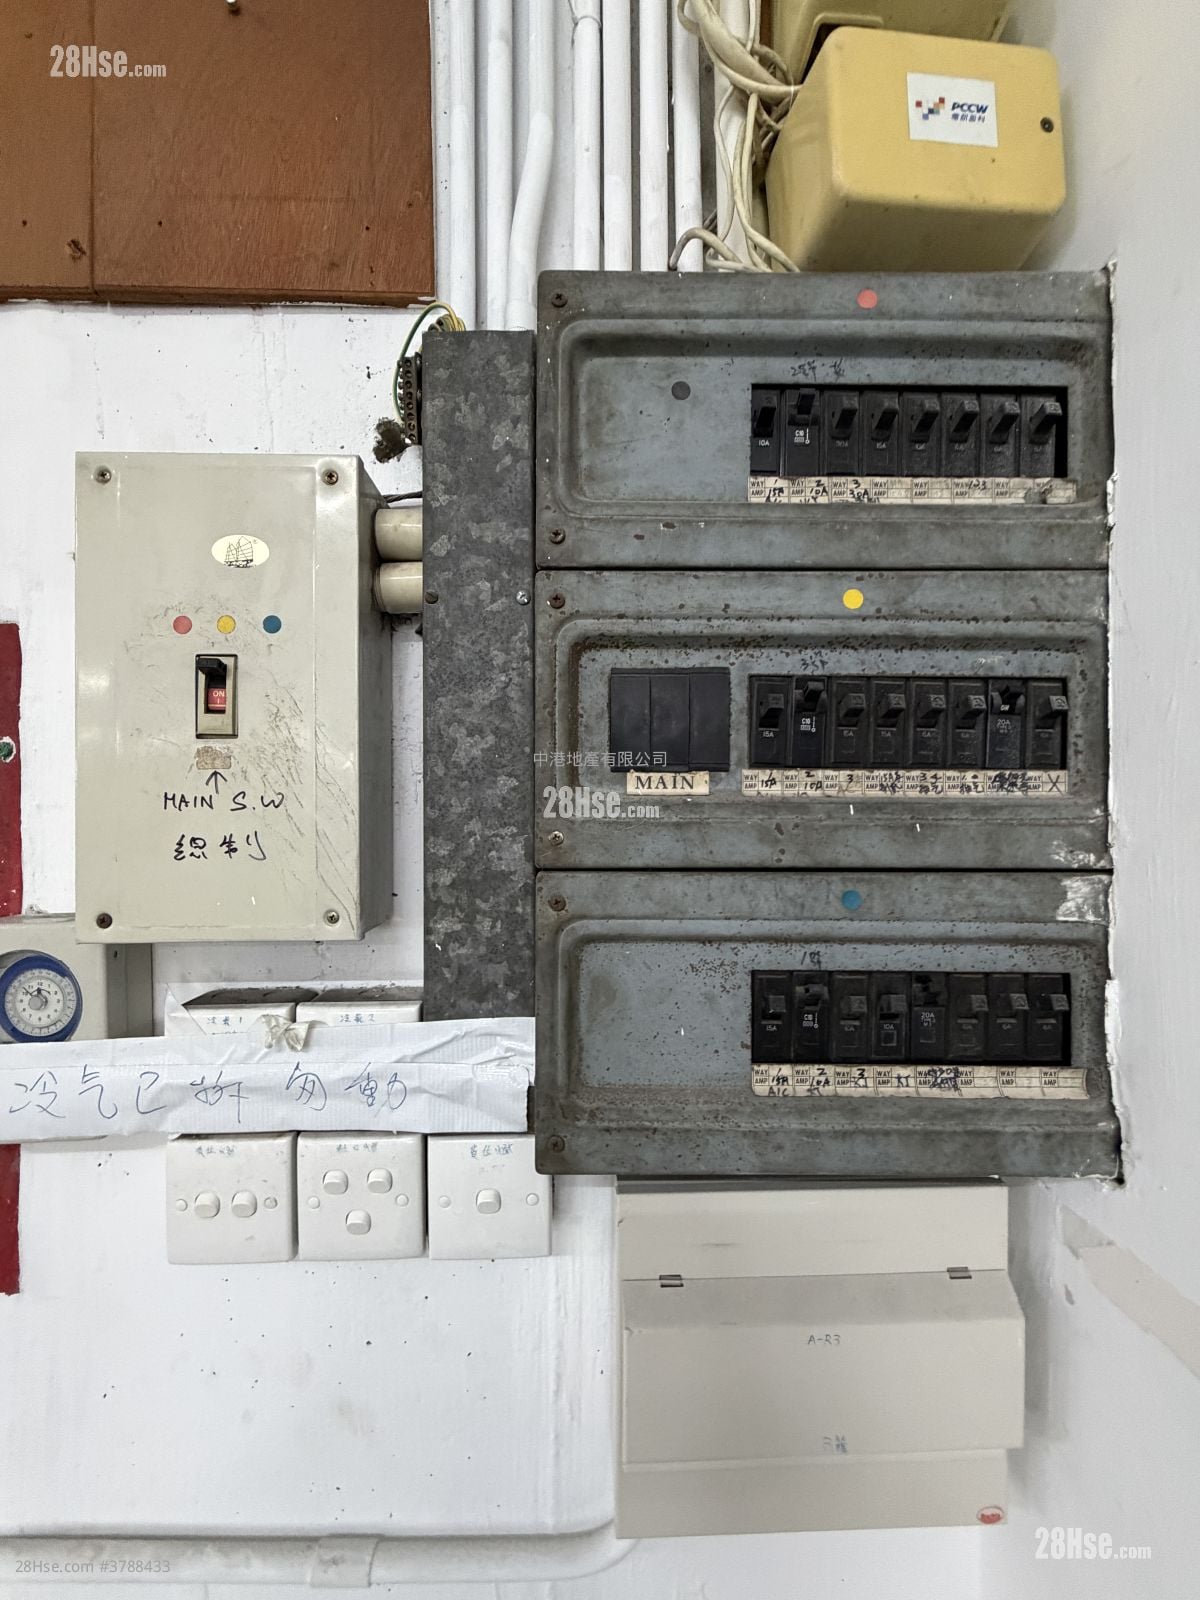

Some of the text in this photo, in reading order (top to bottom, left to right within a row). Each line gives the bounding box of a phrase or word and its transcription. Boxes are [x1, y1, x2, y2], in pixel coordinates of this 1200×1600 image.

[951, 102, 988, 114] PCCW
[852, 479, 861, 489] 3
[635, 776, 695, 789] MAIN
[164, 791, 214, 811] MAIN
[857, 1068, 866, 1078] 3
[808, 1334, 841, 1345] A-R3
